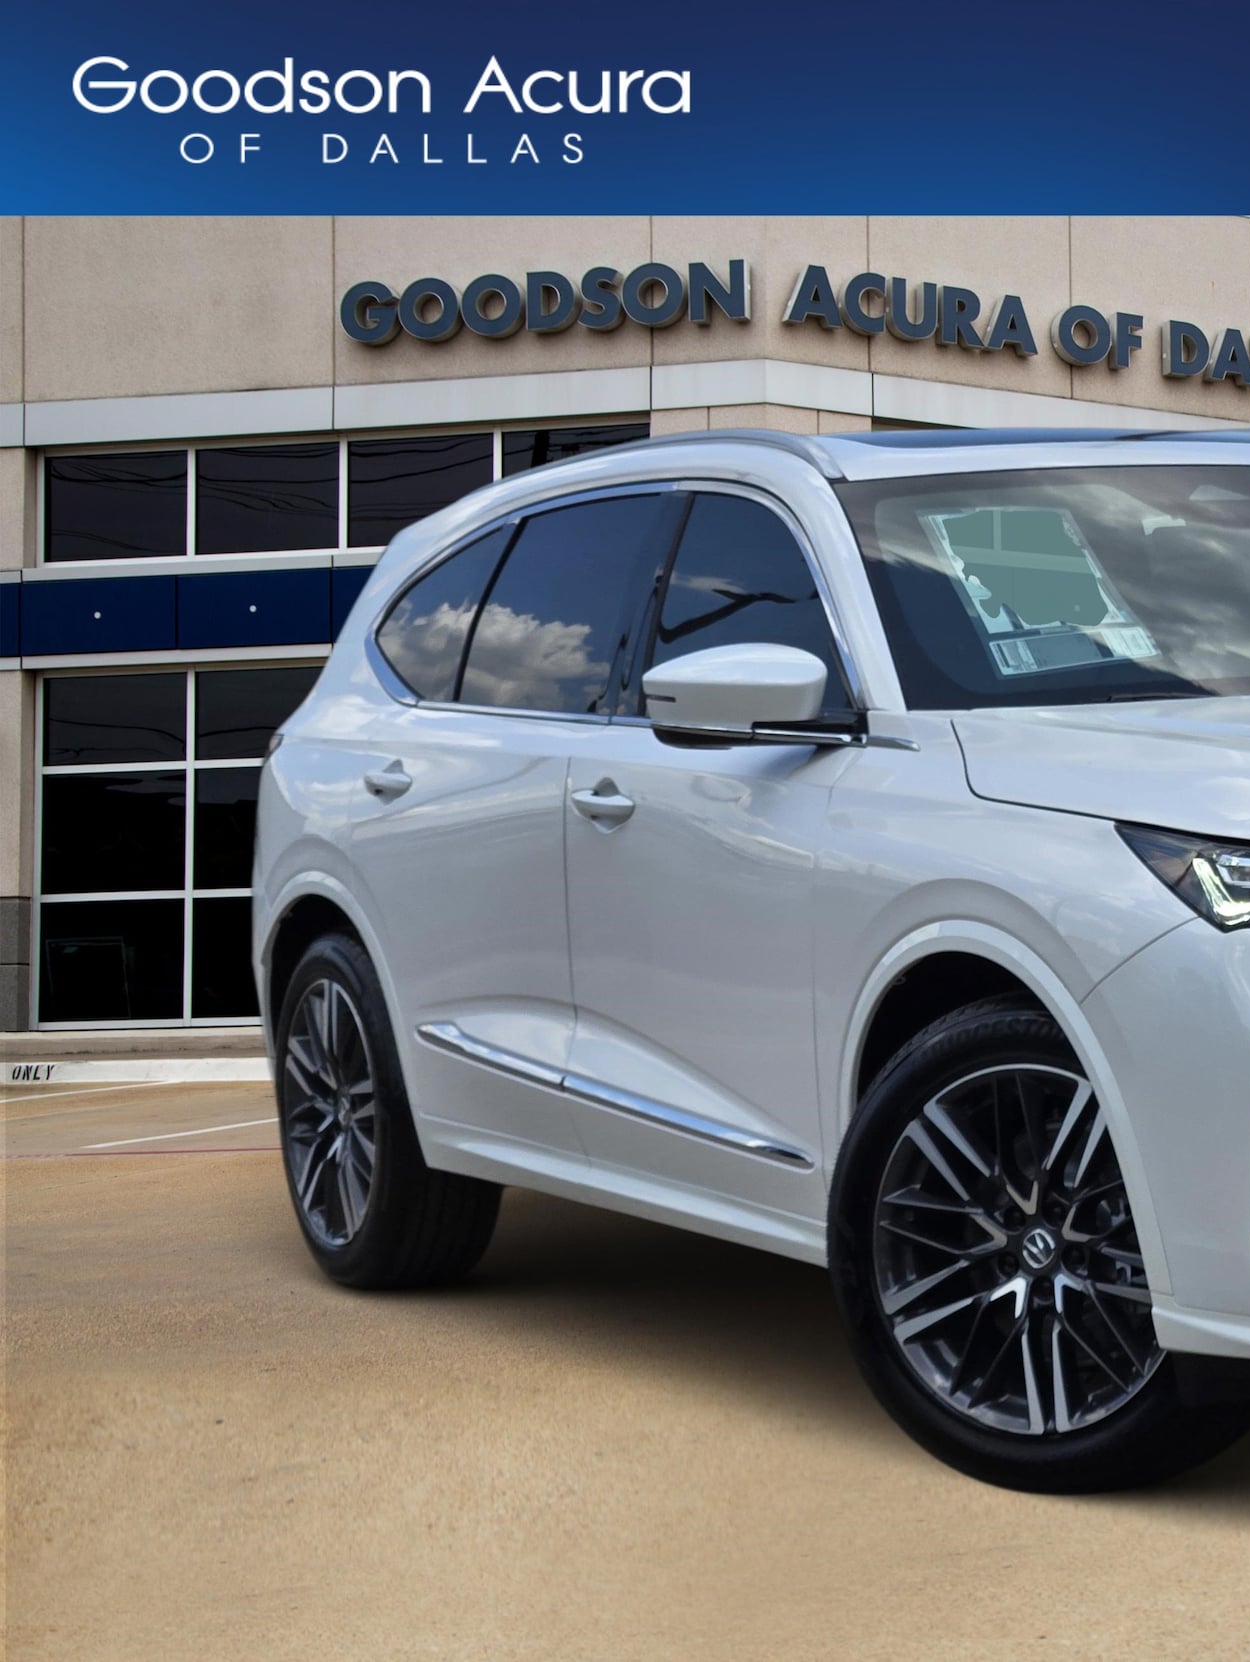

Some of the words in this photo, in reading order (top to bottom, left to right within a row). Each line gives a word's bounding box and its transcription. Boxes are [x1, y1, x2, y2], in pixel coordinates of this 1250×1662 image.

[340, 258, 750, 346] GOODSON
[783, 264, 1039, 356] ACURA
[1052, 304, 1143, 370] OF
[11, 1064, 55, 1081] ONLY
